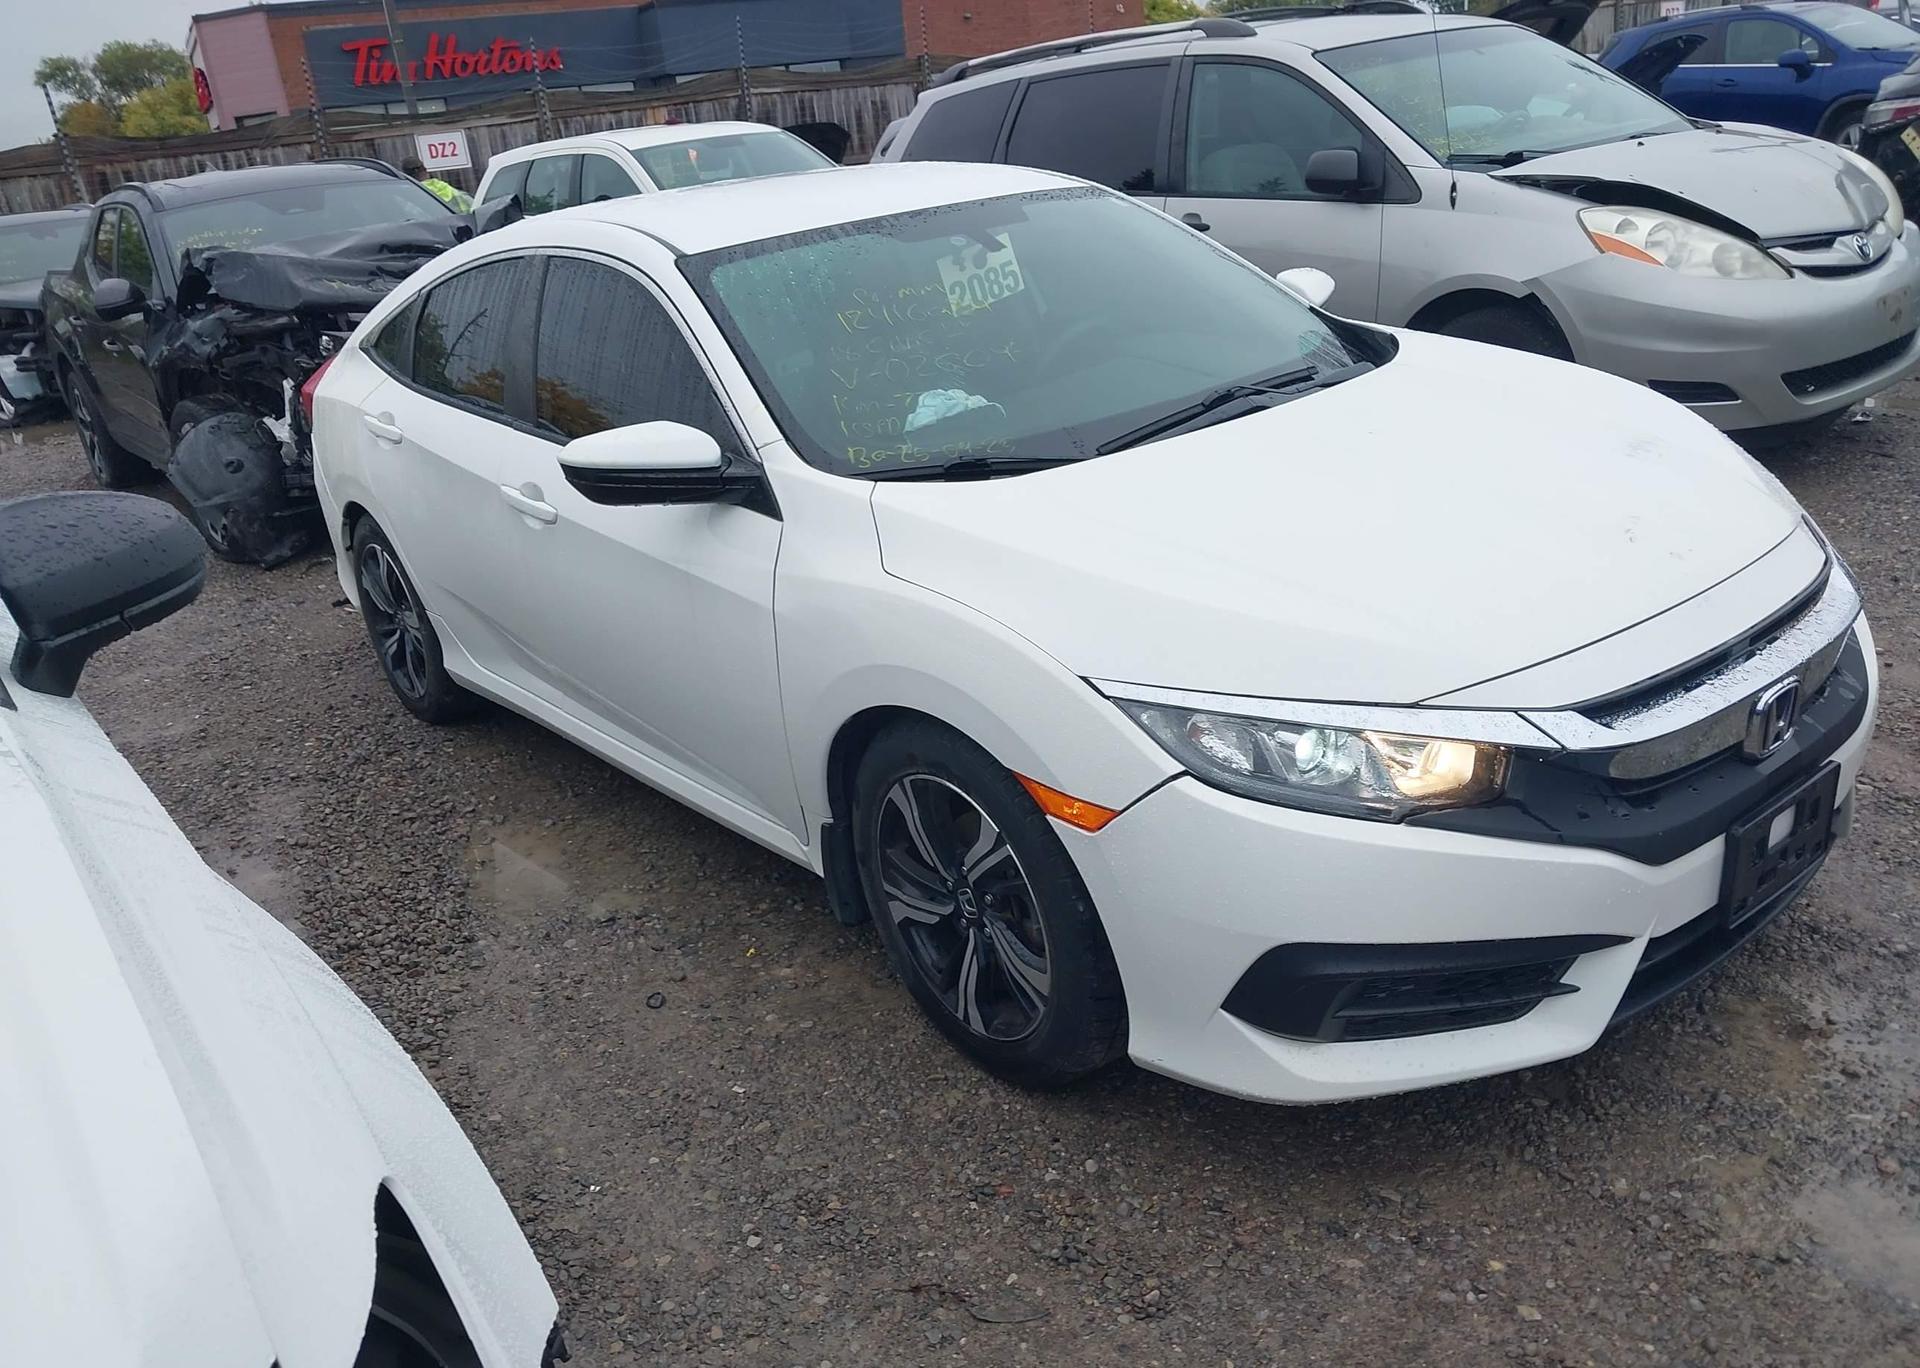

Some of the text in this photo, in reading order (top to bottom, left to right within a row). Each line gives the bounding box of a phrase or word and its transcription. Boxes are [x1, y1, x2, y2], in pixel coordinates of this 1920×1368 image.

[341, 32, 564, 87] Tim Hortons
[427, 141, 459, 160] DZ2
[949, 259, 1021, 305] 2085
